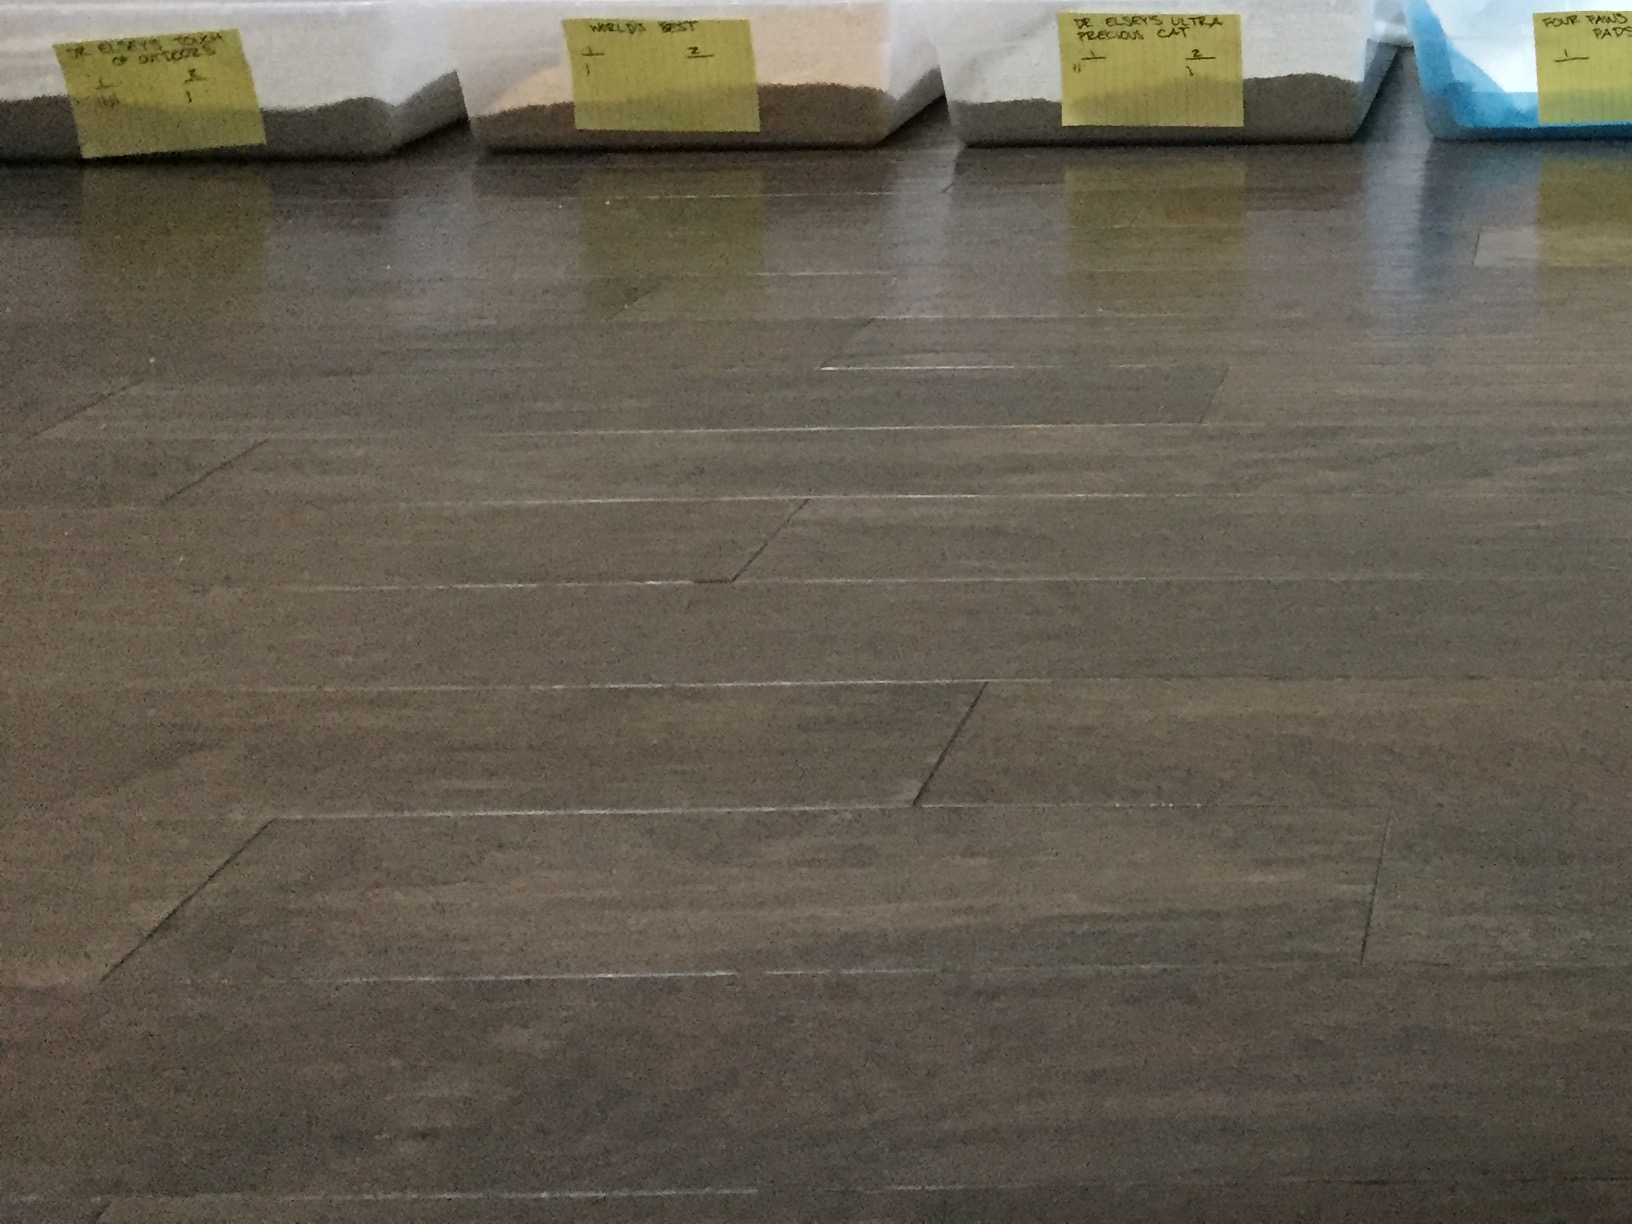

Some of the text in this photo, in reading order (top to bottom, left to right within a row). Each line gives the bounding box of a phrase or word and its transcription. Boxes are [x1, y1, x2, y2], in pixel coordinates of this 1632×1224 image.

[657, 19, 699, 33] BEST
[1073, 17, 1093, 30] DR
[1171, 16, 1224, 28] ULTRA
[1541, 14, 1580, 28] FOUR
[1585, 13, 1628, 25] PAWS
[1076, 26, 1190, 41] PRECIOUS CAT
